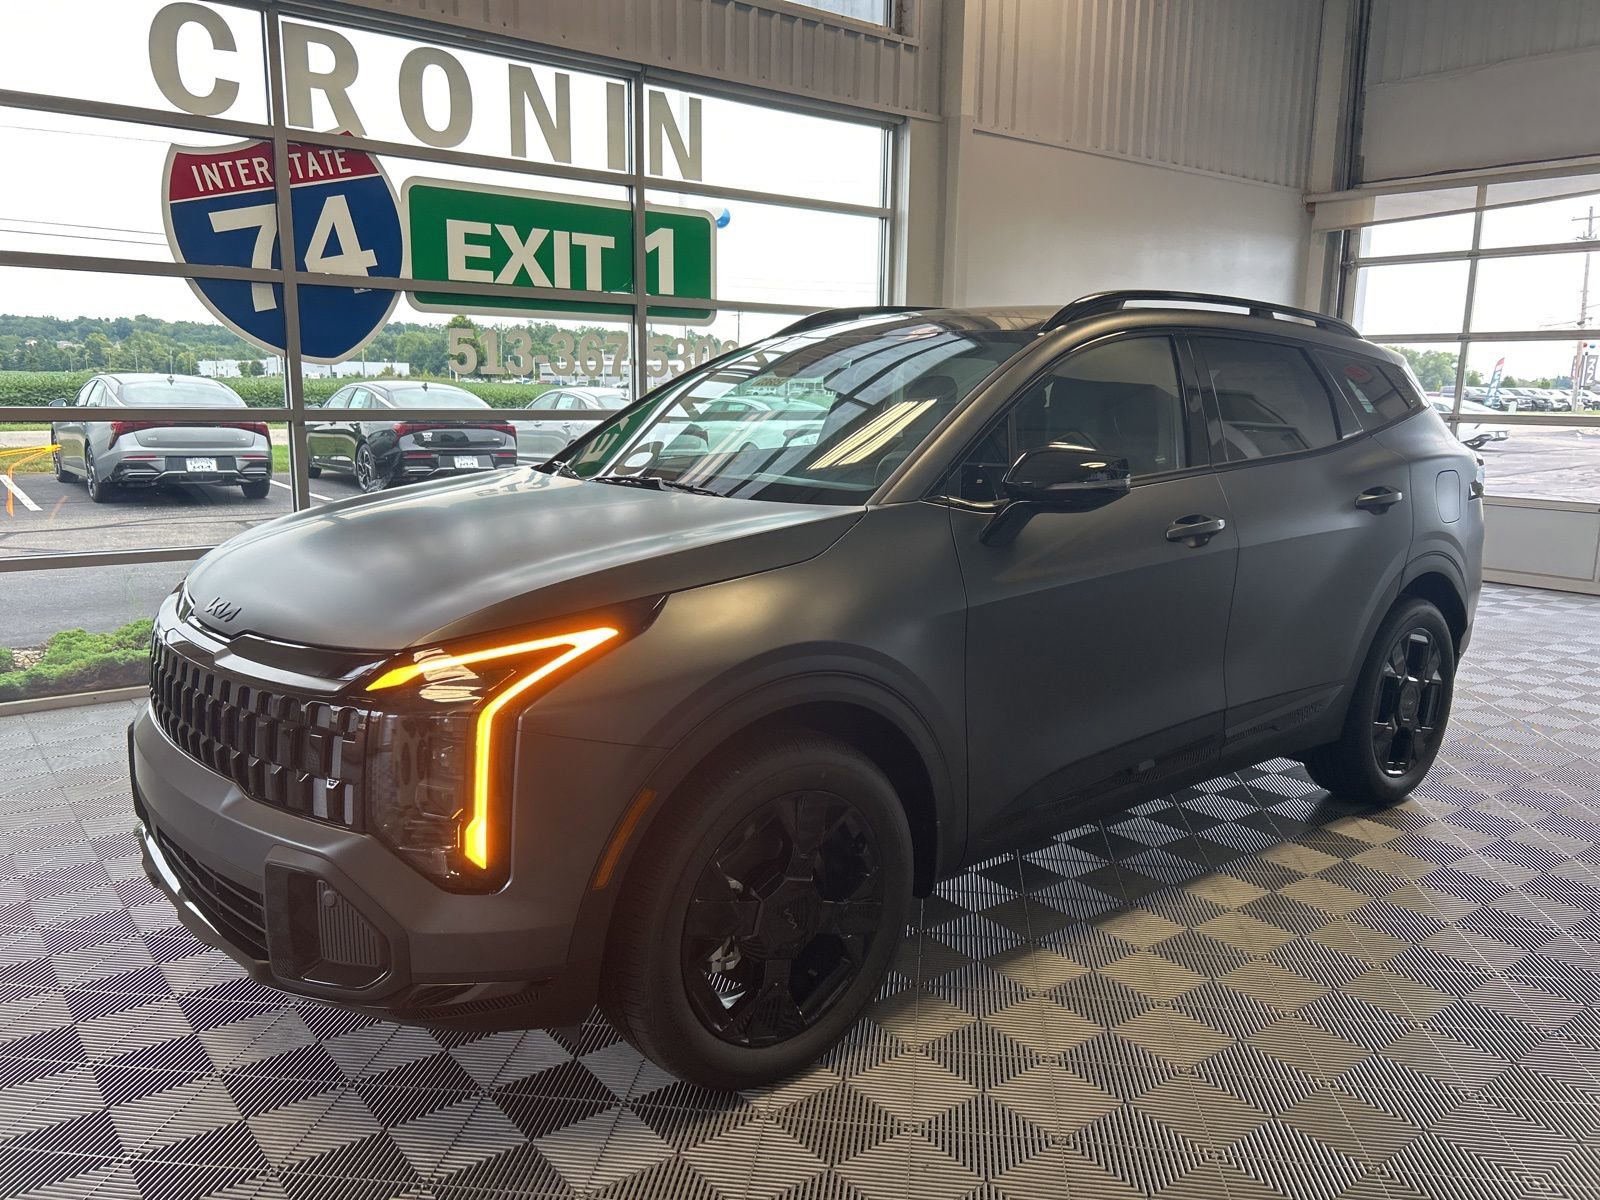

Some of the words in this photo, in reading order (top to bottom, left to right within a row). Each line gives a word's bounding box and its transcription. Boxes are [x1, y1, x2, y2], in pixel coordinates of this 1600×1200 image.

[148, 2, 702, 181] CRONIN
[191, 149, 352, 192] INTERTATE
[208, 195, 378, 312] 74
[446, 219, 615, 291] EXIT
[645, 227, 674, 295] 1
